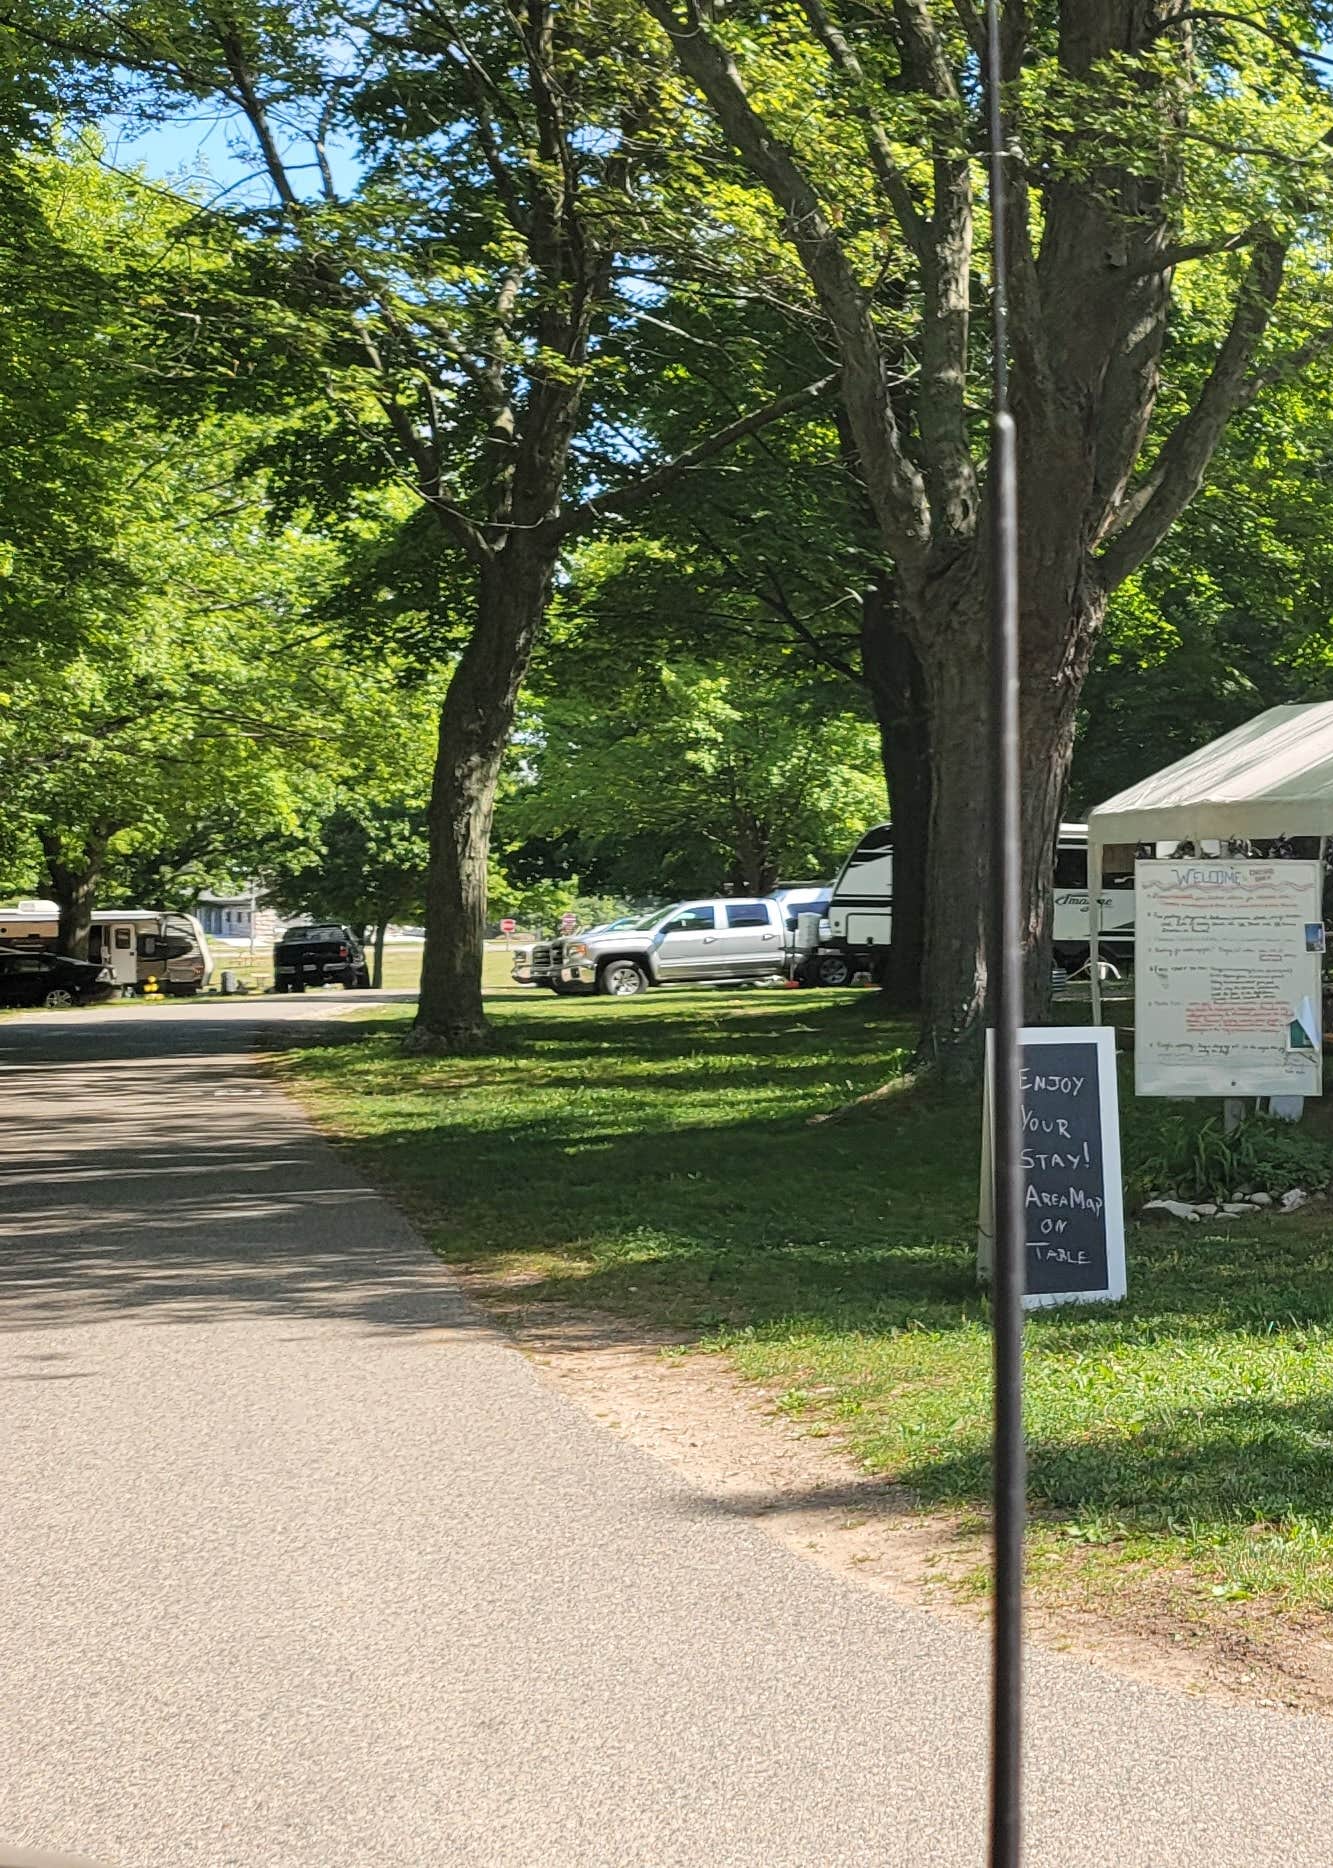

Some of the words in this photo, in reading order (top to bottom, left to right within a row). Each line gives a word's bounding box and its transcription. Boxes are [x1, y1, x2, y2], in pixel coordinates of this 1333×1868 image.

[1171, 867, 1242, 886] WELCOME
[1019, 1067, 1085, 1096] ENJOY
[1021, 1104, 1071, 1138] YOUR
[1019, 1141, 1090, 1170] STAY!
[1041, 1218, 1067, 1234] ON
[1025, 1242, 1092, 1264] TABLE
